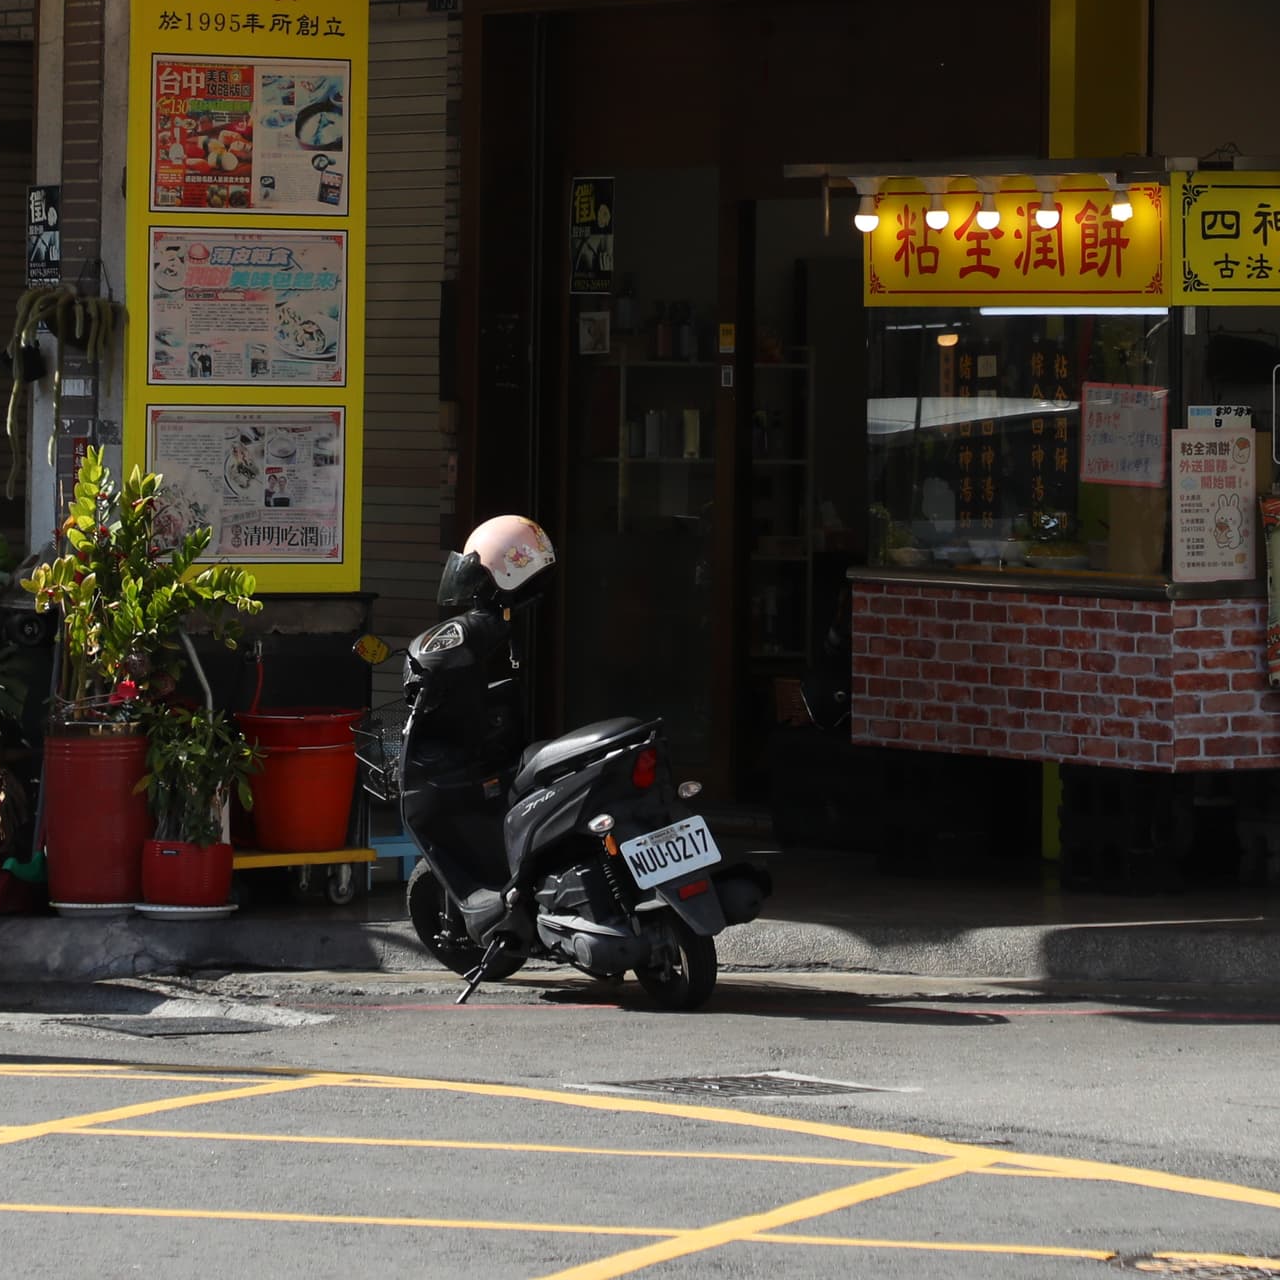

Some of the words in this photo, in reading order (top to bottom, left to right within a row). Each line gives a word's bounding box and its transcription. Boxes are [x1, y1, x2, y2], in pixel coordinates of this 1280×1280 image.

[158, 10, 346, 37] 於1995年所創立
[159, 67, 206, 97] 台中
[894, 199, 1130, 278] 粘全潤餅
[628, 827, 710, 879] NUU-0217
